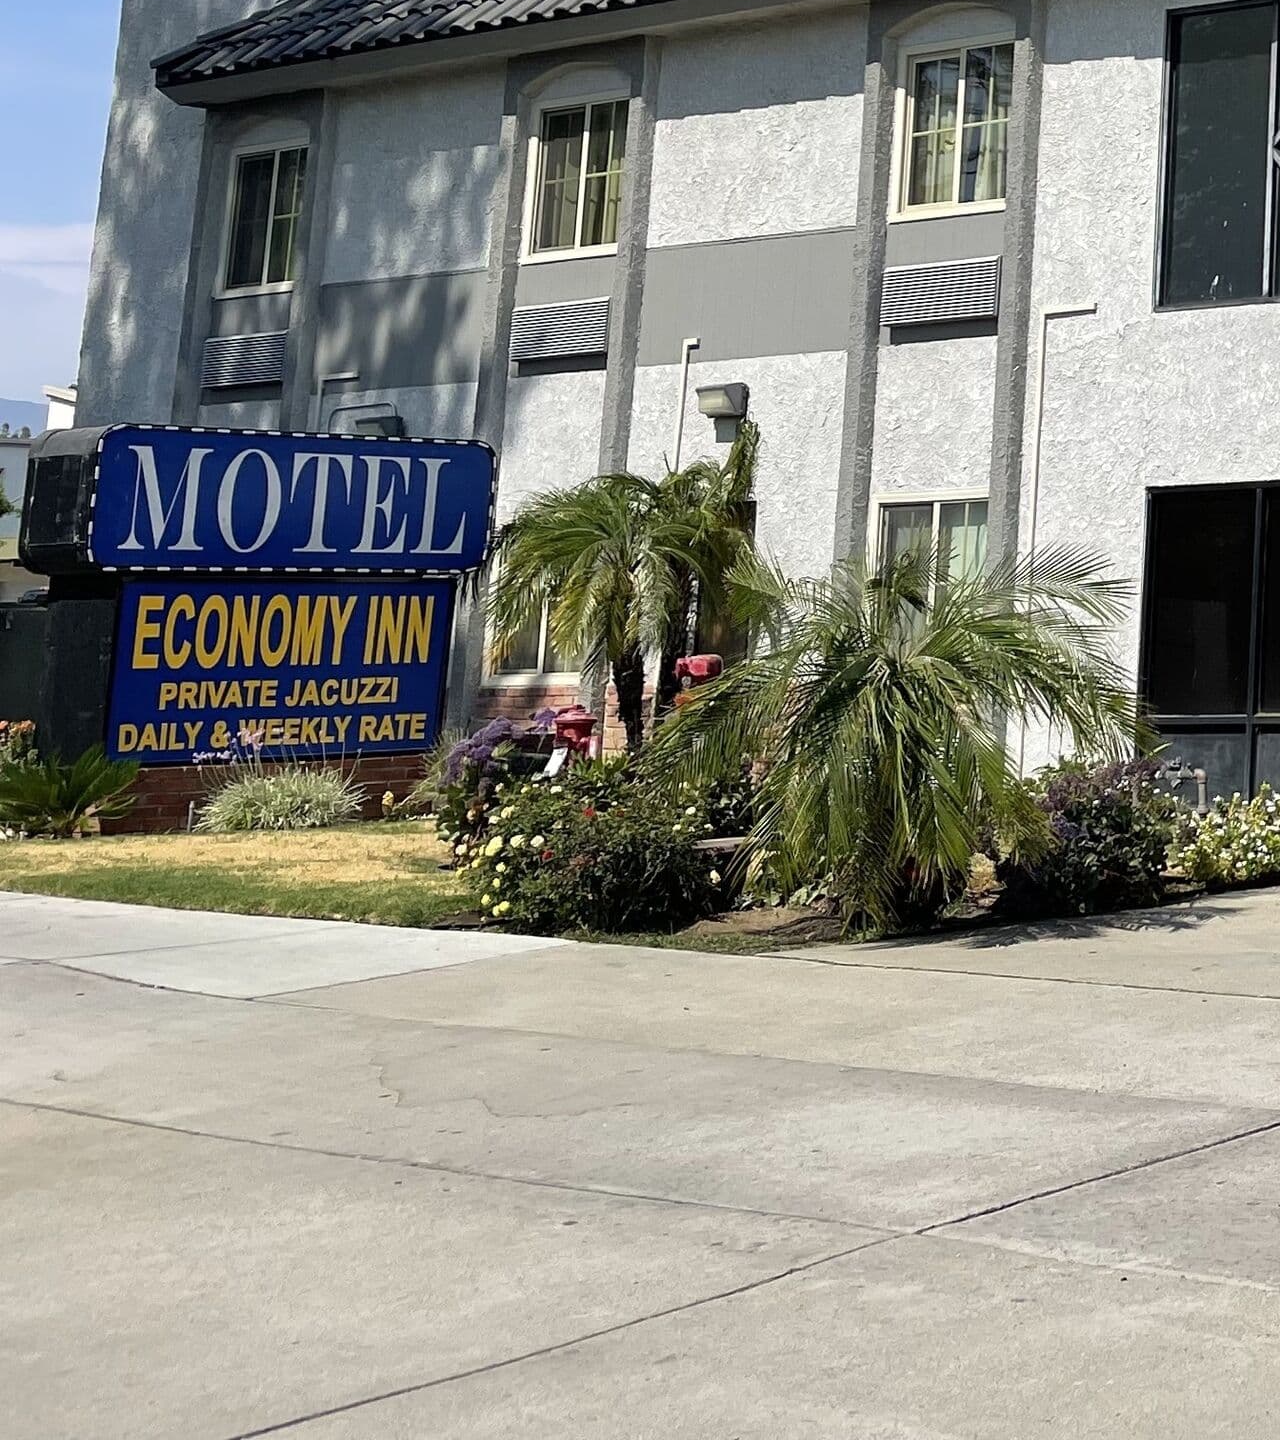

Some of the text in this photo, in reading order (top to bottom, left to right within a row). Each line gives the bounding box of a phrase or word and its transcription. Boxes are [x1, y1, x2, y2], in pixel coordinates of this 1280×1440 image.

[117, 444, 467, 555] MOTEL
[132, 594, 435, 670] ECONOMY INN
[158, 677, 399, 710] PRIVATE JACUZZI
[118, 713, 427, 753] DAILY & WEEKLY RATE
